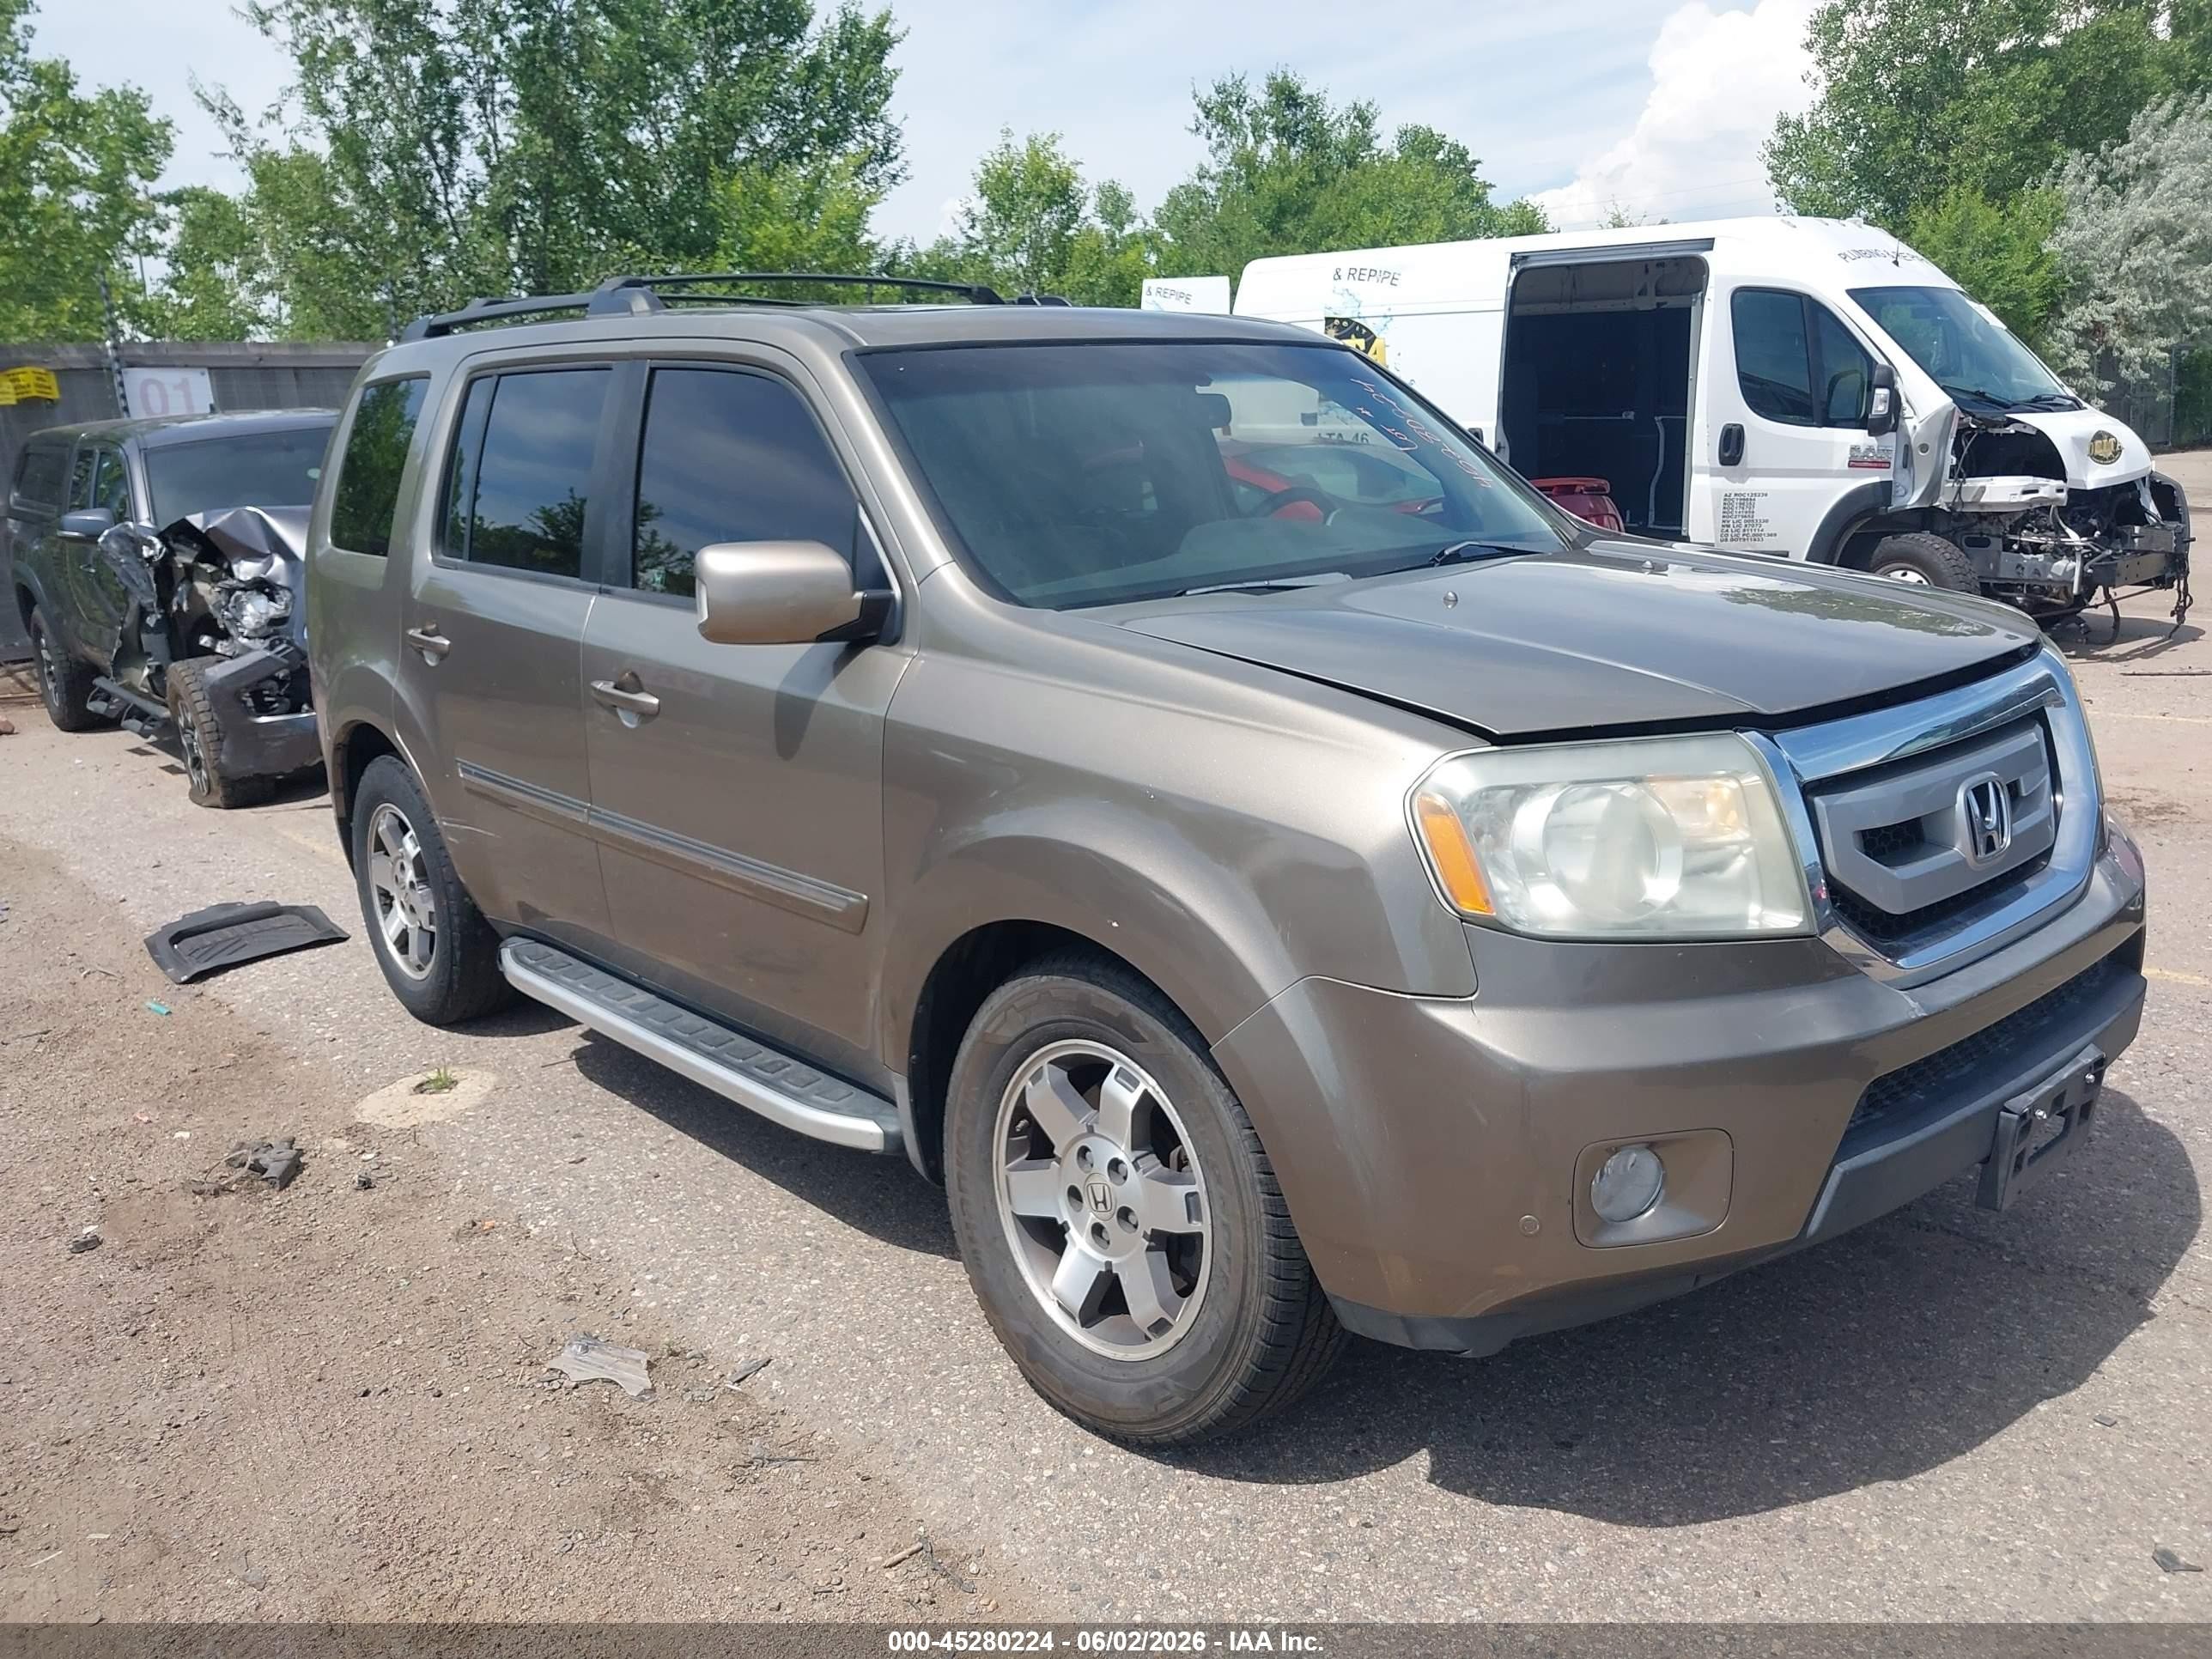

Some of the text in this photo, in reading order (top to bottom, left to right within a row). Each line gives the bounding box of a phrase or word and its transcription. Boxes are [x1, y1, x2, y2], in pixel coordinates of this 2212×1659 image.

[1333, 267, 1401, 287] & REPIPE
[1155, 287, 1193, 305] REPIPE
